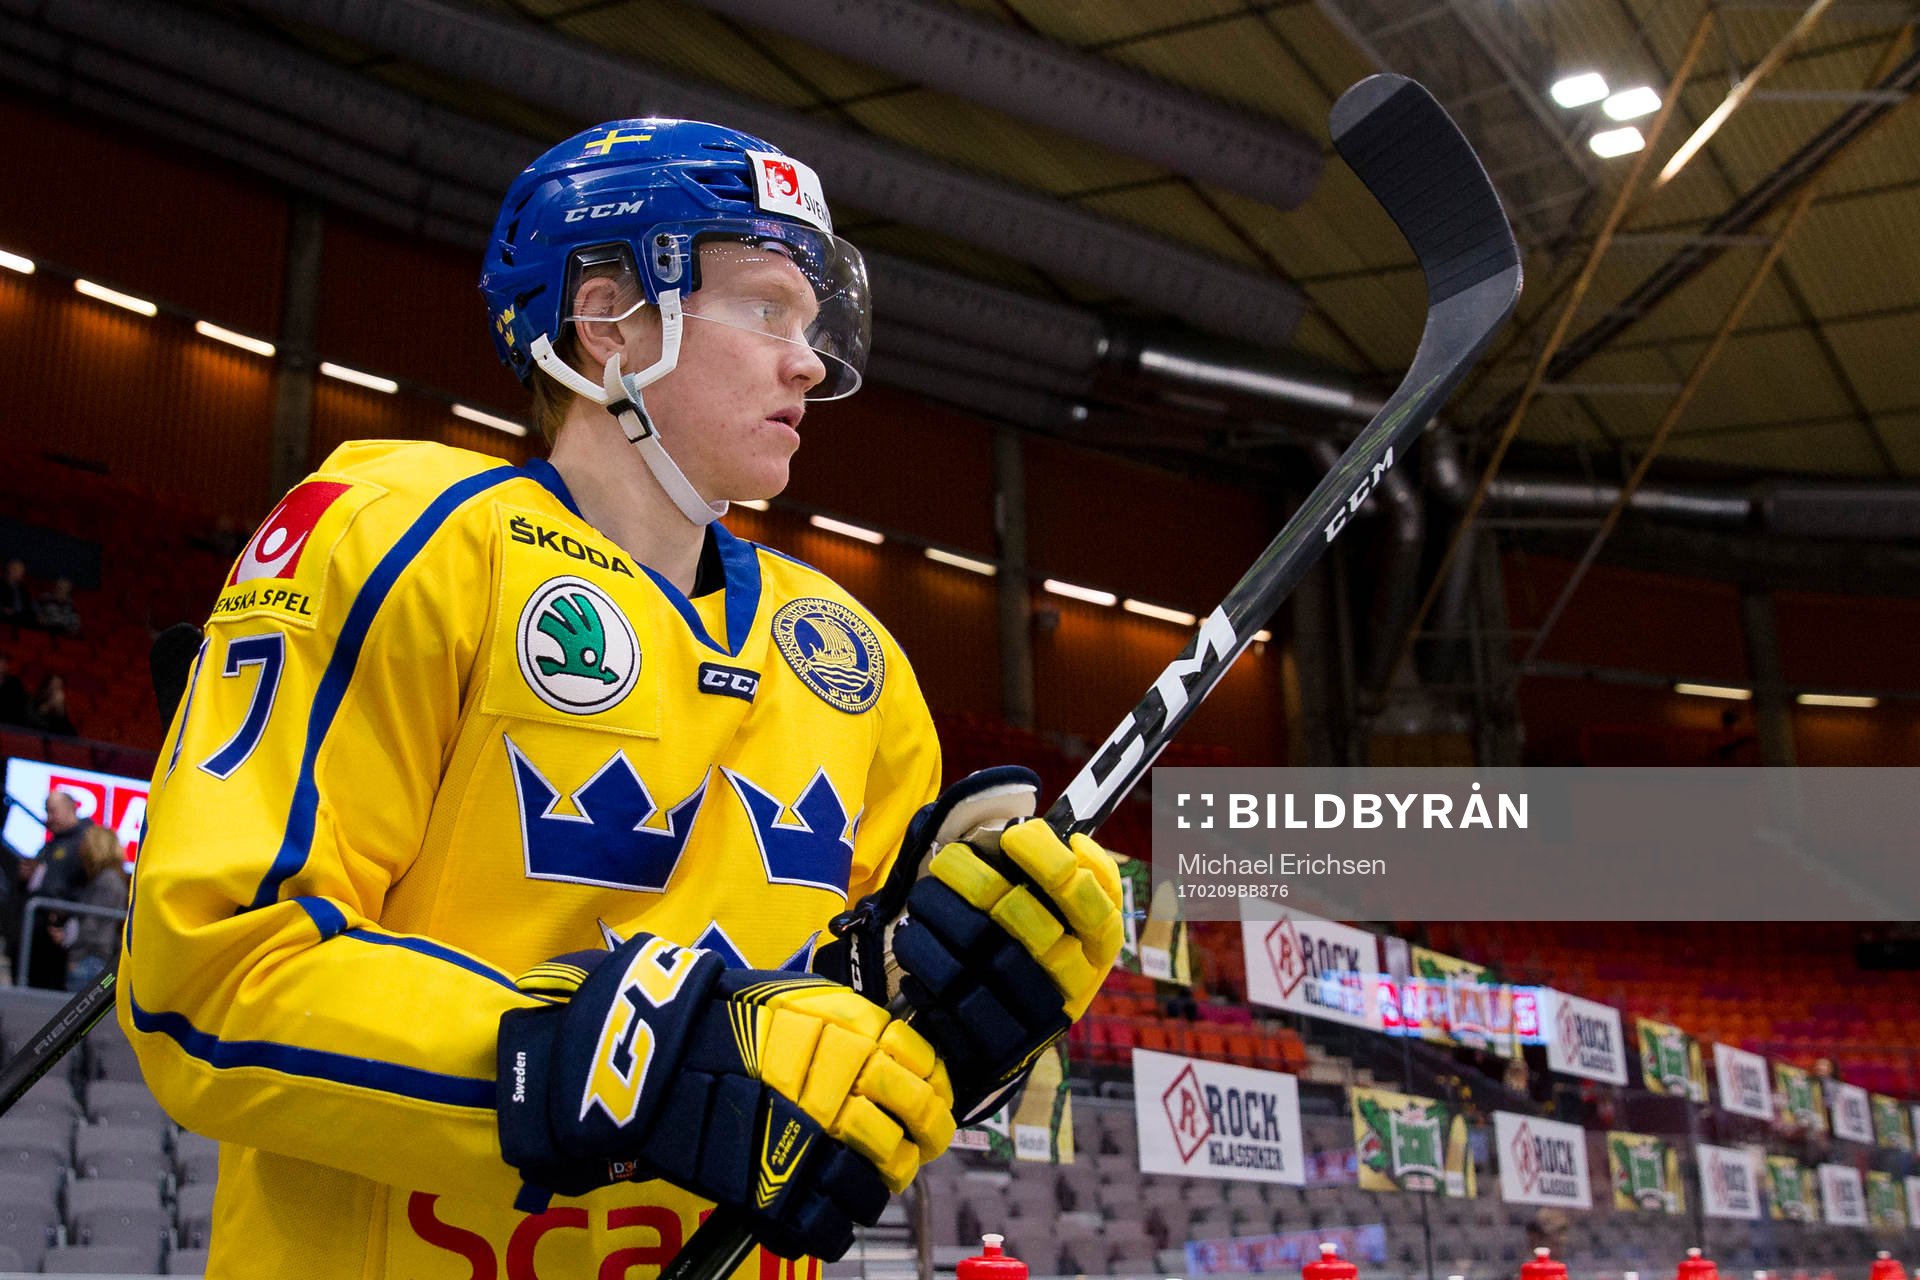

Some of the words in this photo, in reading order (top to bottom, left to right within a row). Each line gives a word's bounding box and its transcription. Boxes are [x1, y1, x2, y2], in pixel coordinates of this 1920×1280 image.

[565, 200, 644, 223] CCM
[1325, 446, 1394, 542] CCM
[510, 516, 634, 578] ŠKODA
[213, 590, 257, 614] ENSKA
[259, 588, 311, 615] SPEL
[1065, 604, 1237, 821] CM
[579, 937, 712, 1128] CC
[512, 1051, 527, 1103] Sweden
[771, 1118, 796, 1165] ATTACK
[1205, 1084, 1280, 1142] ROCK
[778, 1123, 801, 1166] SHIELD
[408, 1190, 820, 1280] Sca
